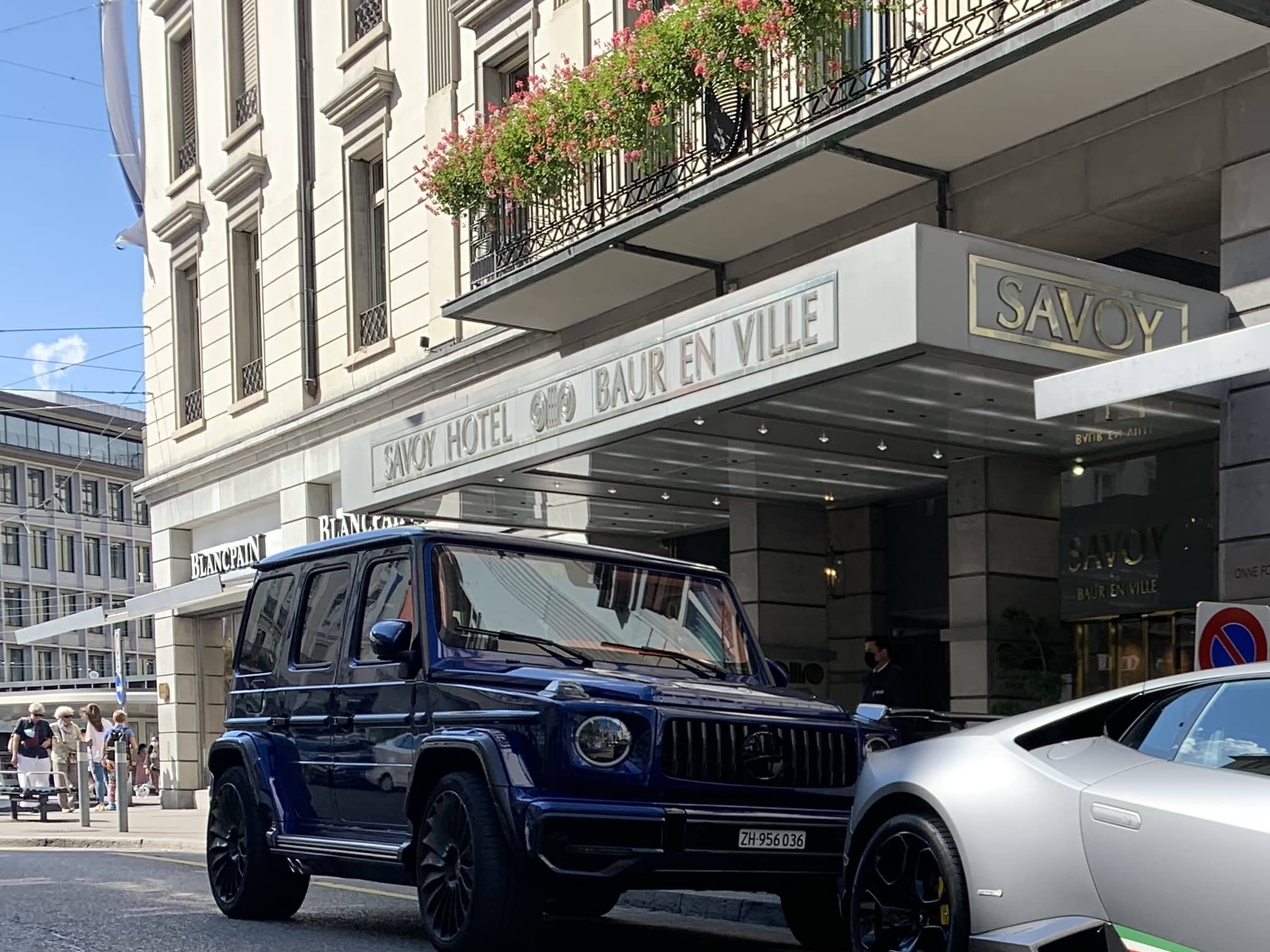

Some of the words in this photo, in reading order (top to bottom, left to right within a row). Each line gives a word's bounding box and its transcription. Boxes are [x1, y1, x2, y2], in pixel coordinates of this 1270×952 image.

[996, 275, 1165, 353] SAVOY
[384, 428, 437, 482] SAVOY
[446, 402, 513, 462] HOTEL
[594, 345, 667, 413] BAUR
[679, 326, 716, 387] EN
[732, 290, 819, 367] VILLE
[190, 533, 262, 580] BLANCPAIN
[1129, 579, 1158, 595] VILLE
[782, 833, 804, 848] 036
